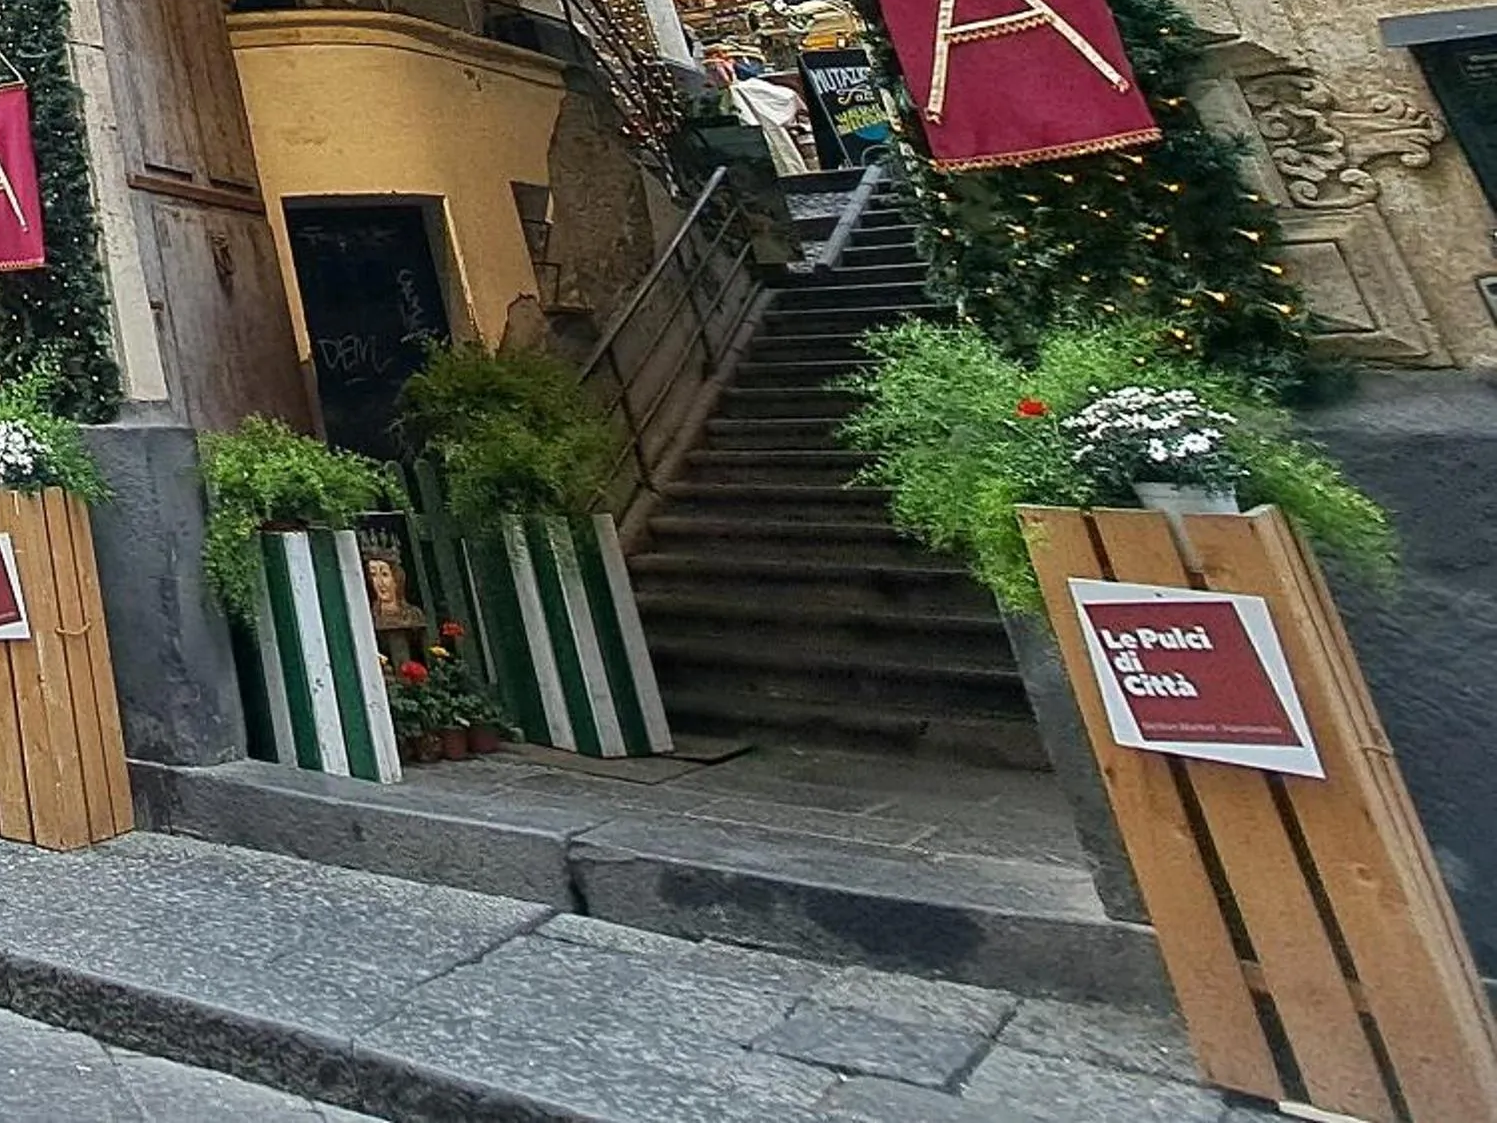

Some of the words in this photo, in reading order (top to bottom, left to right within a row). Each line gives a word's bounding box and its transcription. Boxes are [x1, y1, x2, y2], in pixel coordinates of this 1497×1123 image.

[1100, 628, 1140, 651] Le
[1139, 626, 1213, 650] Pulci
[1113, 651, 1145, 673] di
[1121, 673, 1199, 698] Città
